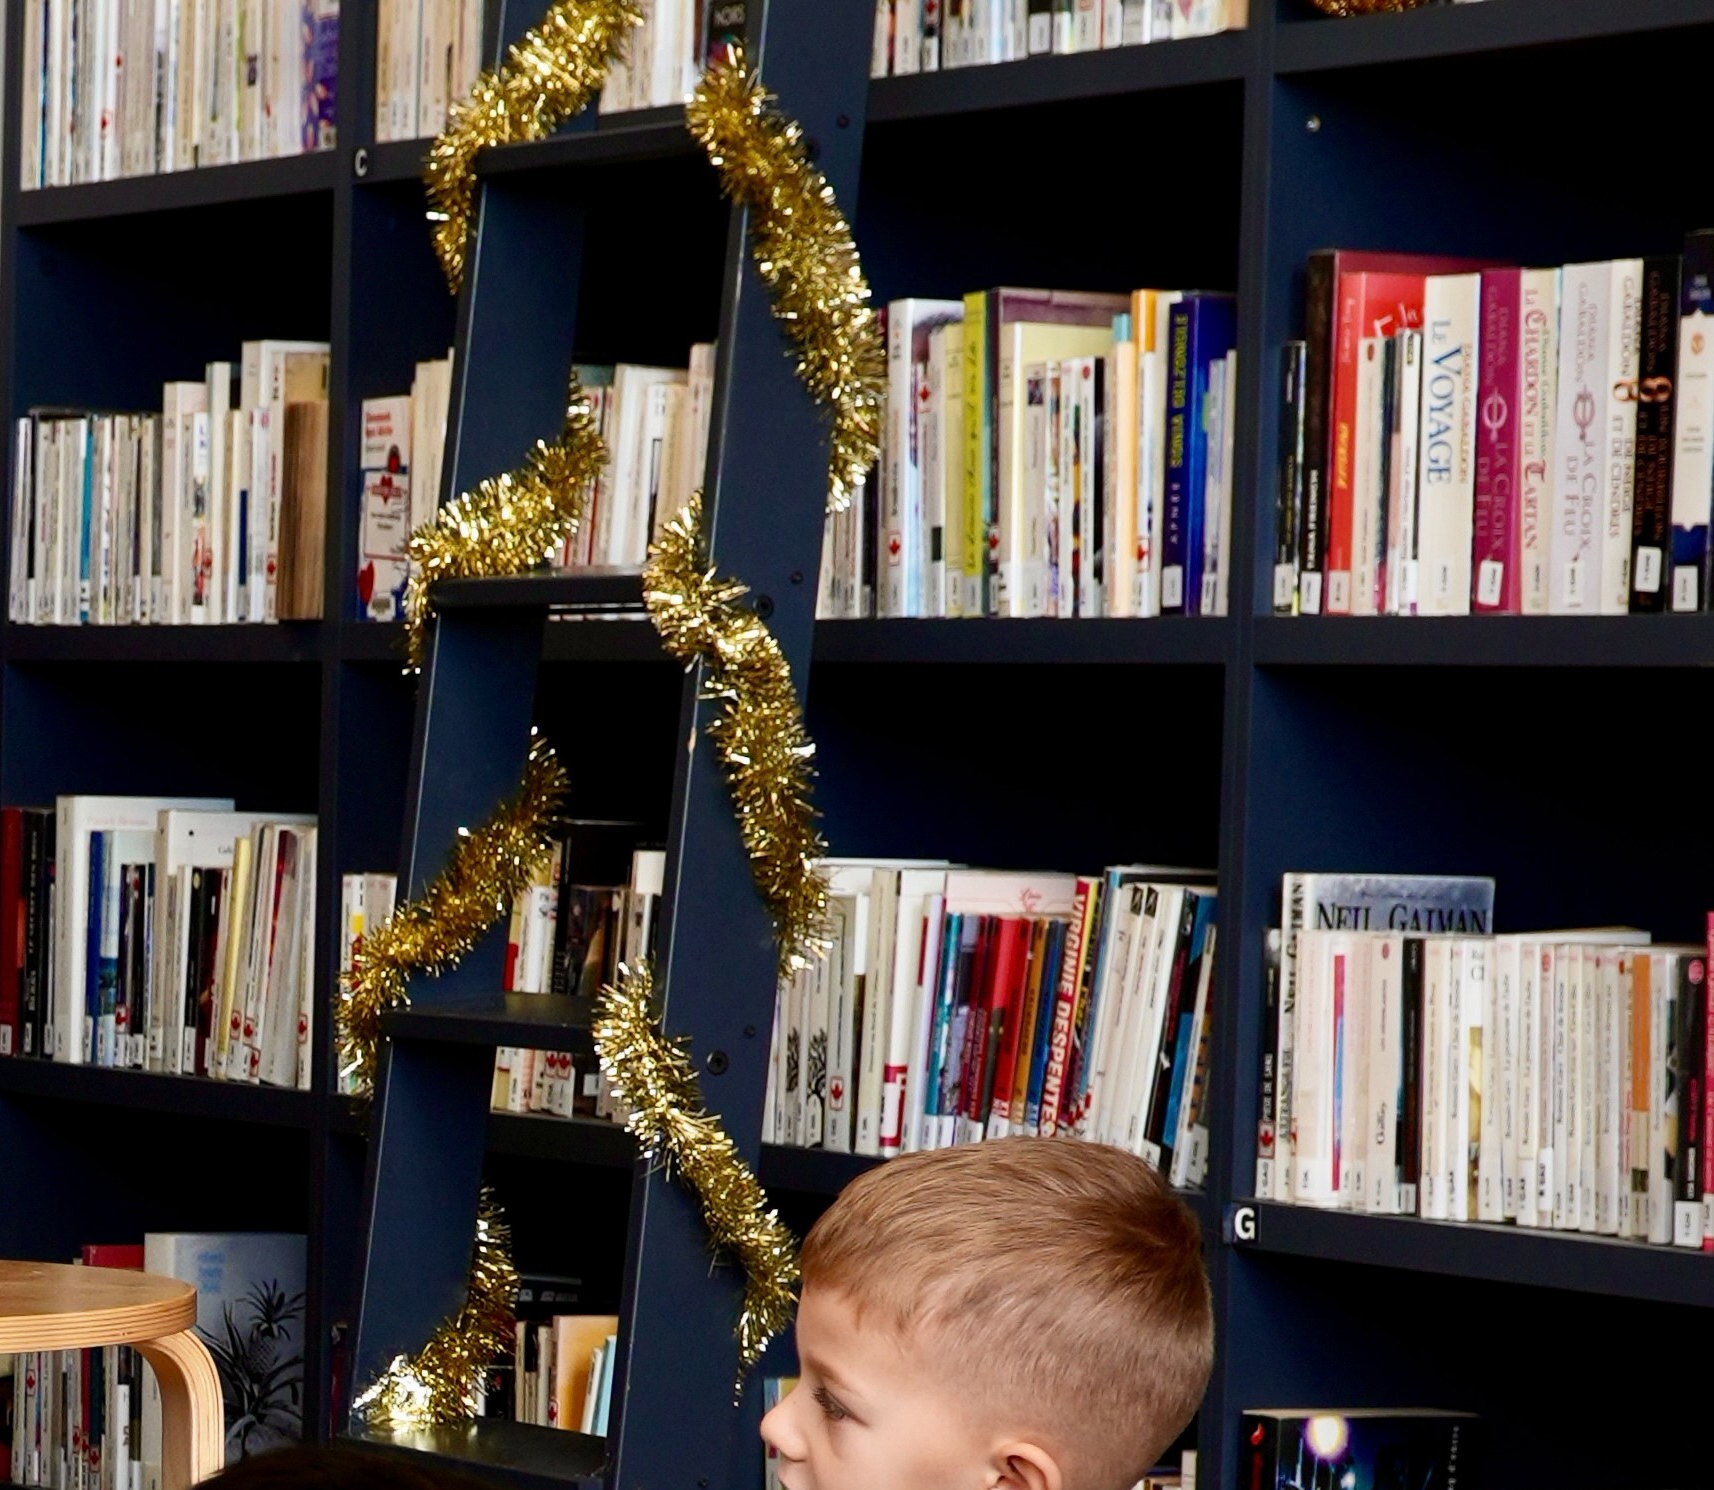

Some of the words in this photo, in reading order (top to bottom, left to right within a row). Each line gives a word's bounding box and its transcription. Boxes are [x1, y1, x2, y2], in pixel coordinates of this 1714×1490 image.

[355, 148, 367, 177] C
[1426, 346, 1463, 486] VOYAGE
[1317, 903, 1372, 932] NEIL
[1389, 903, 1488, 933] GAIMAN
[1059, 893, 1087, 998] VIRGINIE
[1234, 1206, 1256, 1239] G
